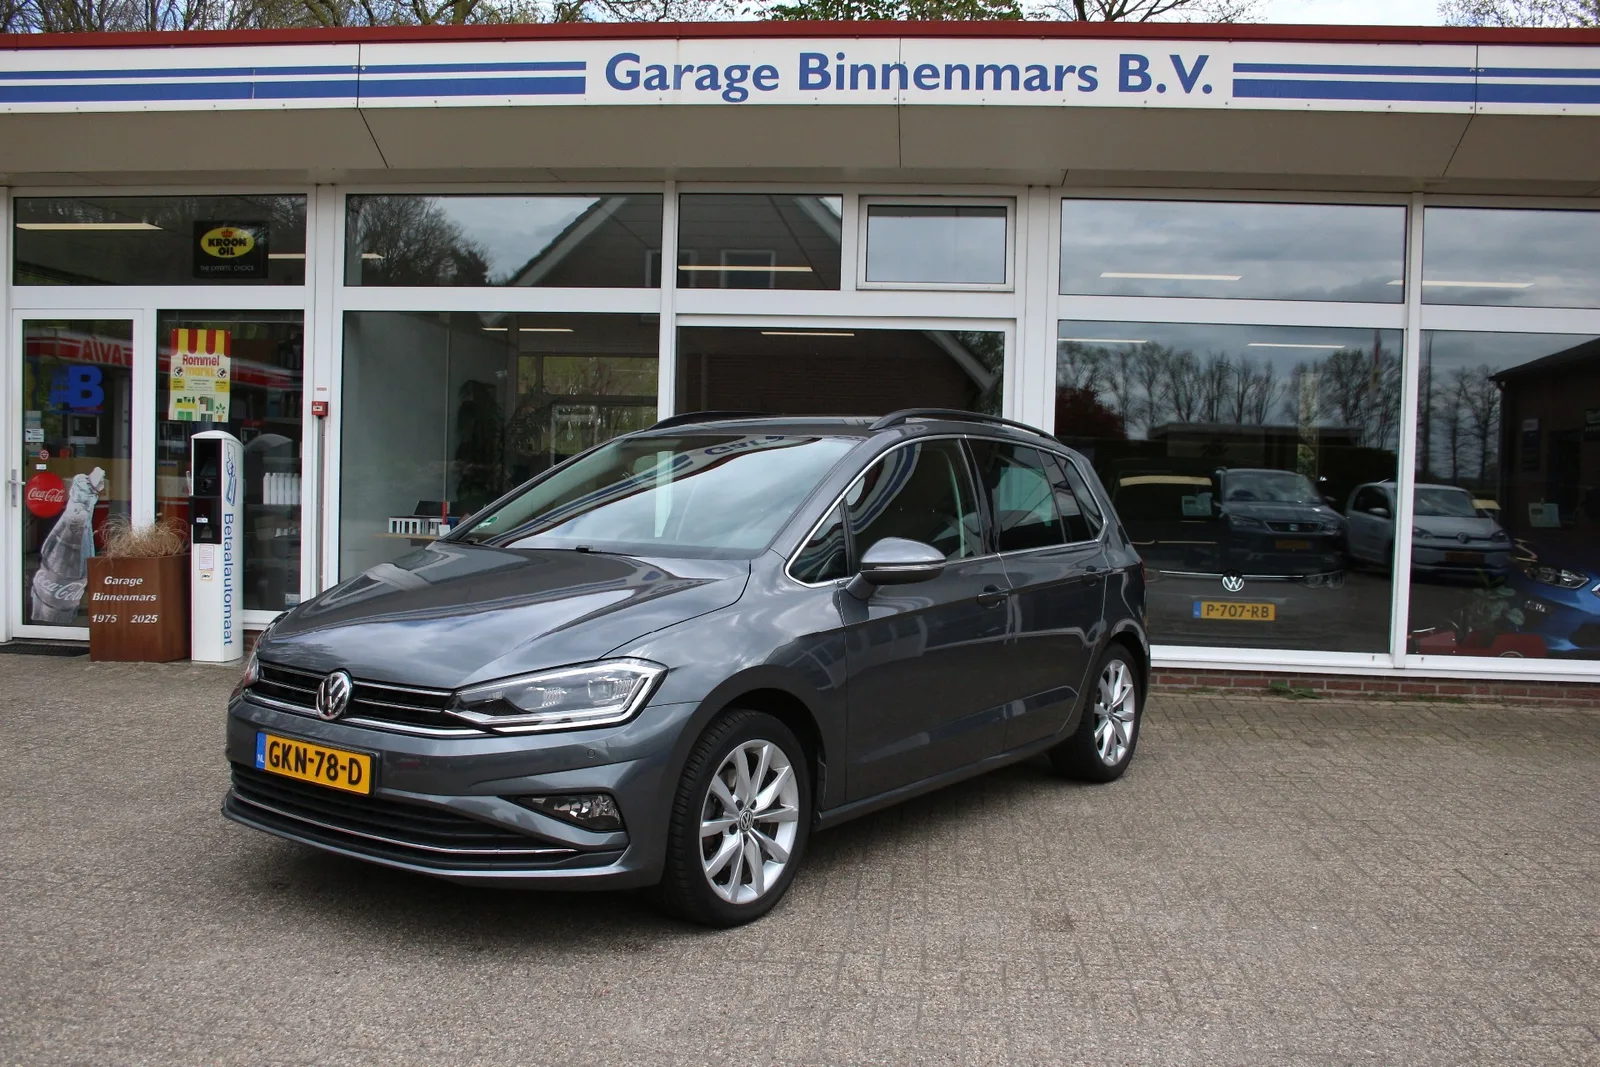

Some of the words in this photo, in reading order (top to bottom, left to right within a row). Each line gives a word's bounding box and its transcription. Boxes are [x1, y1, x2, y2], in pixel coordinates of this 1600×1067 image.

[605, 52, 780, 103] Garage
[800, 51, 1099, 92] Binnenmars
[1118, 53, 1213, 95] B.V.
[207, 238, 248, 247] KROON
[218, 247, 236, 256] OIL
[182, 354, 220, 367] Rommel
[104, 576, 144, 587] Garage
[224, 513, 234, 646] Betaalautomaat
[92, 592, 157, 602] Binnenmars
[1206, 603, 1270, 619] P-707-RB
[91, 614, 118, 623] 1975
[130, 614, 159, 623] 2025
[268, 740, 363, 786] GKN-78-D
